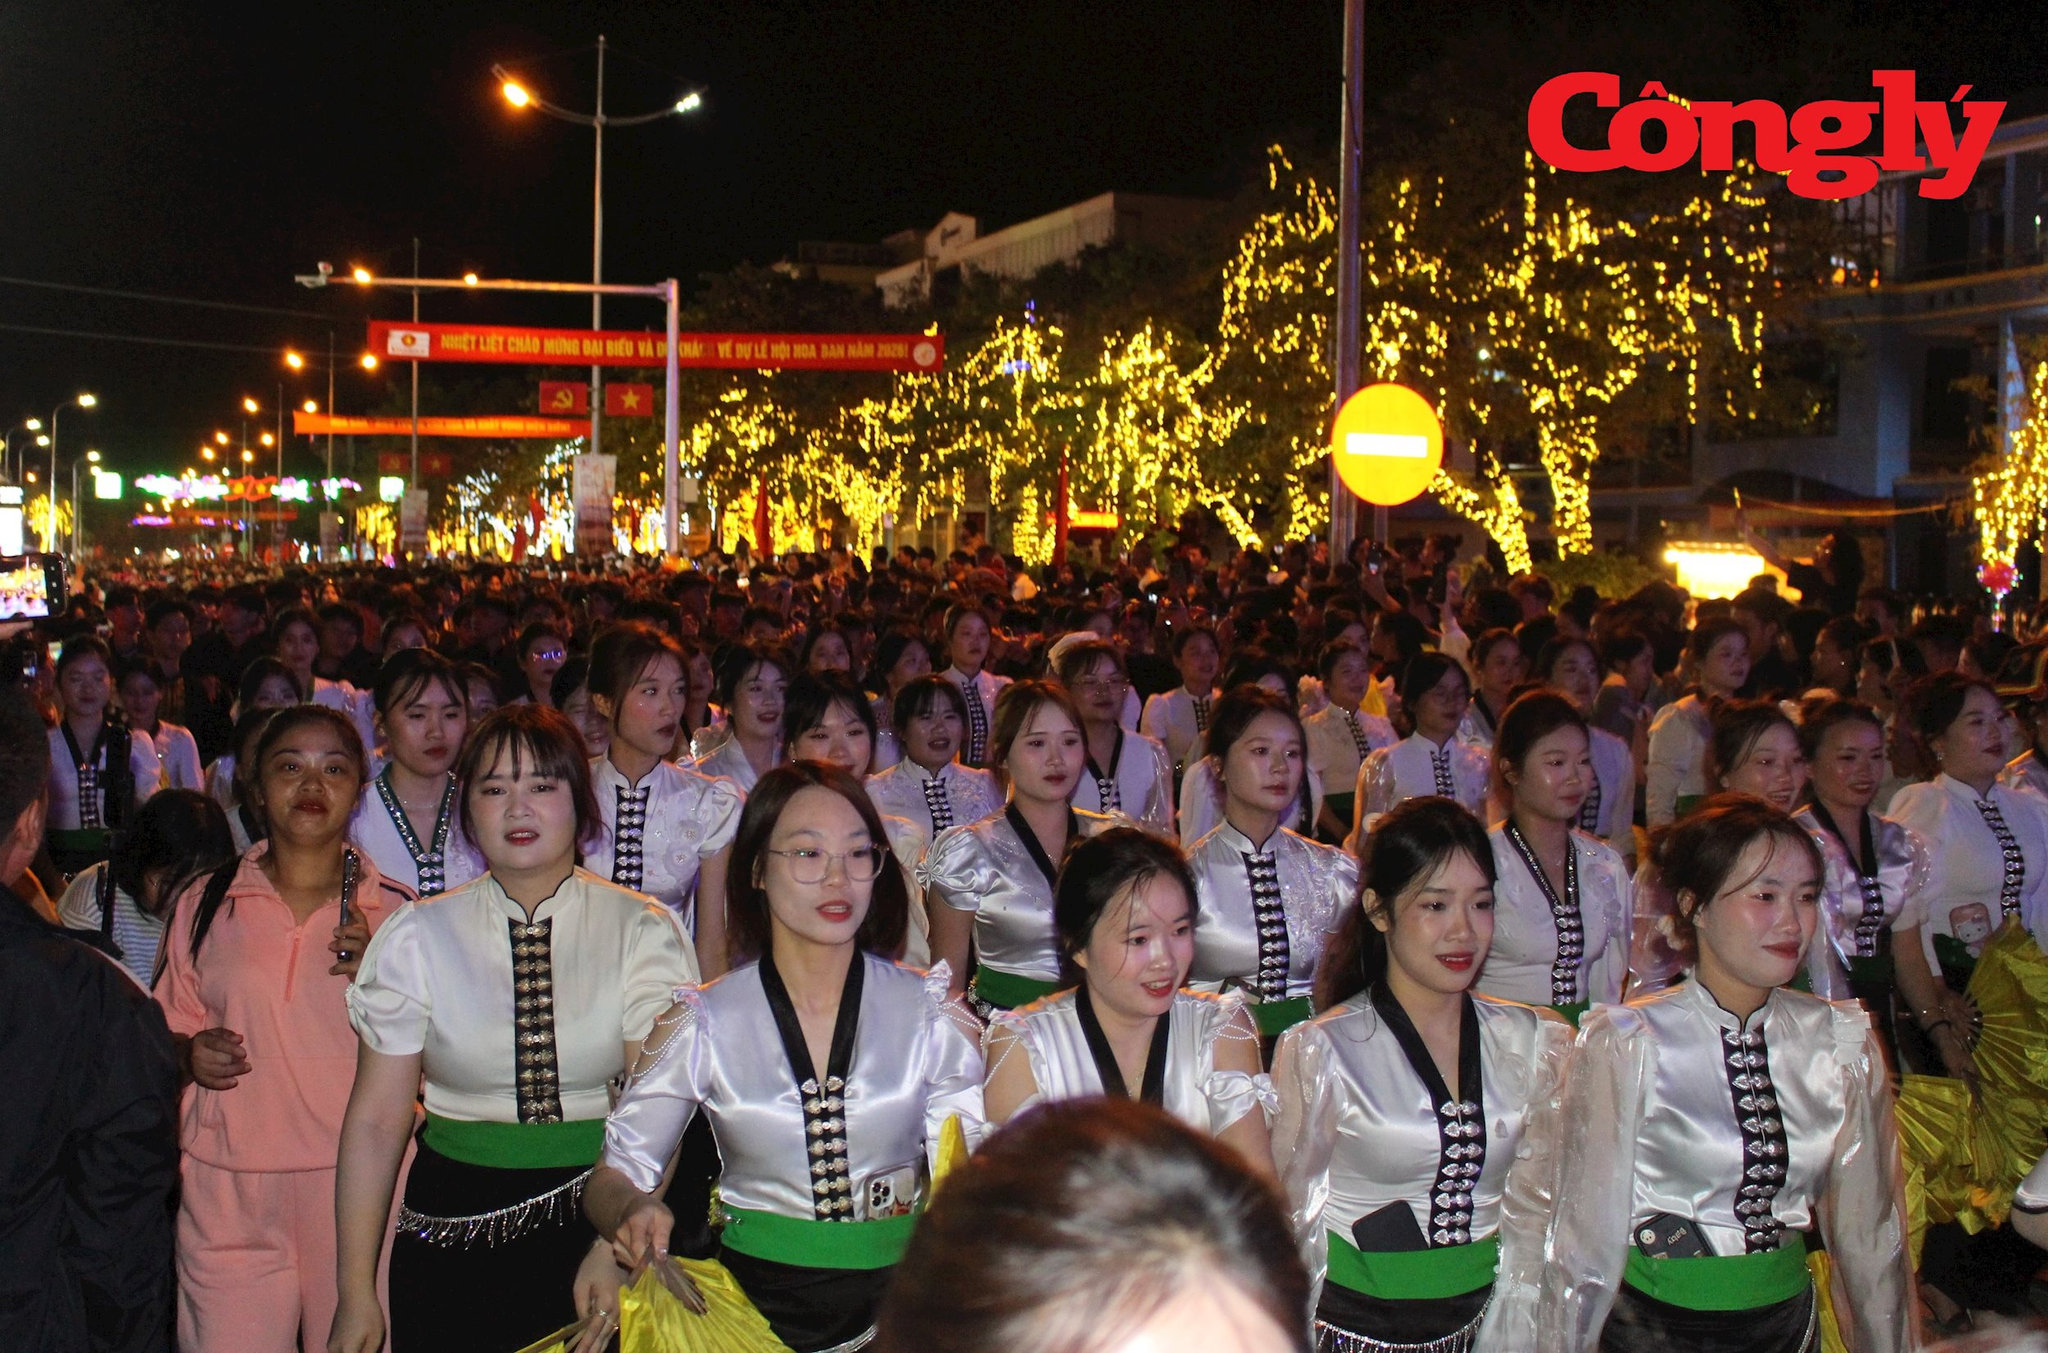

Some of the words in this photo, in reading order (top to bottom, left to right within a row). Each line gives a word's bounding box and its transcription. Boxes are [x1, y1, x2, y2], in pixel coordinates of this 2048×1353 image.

[441, 333, 476, 353] NHIỆT
[480, 333, 504, 354] LIỆT
[508, 335, 541, 354] CHÀO
[638, 338, 654, 358] VÀ
[794, 343, 817, 360] HOA
[822, 344, 845, 360] BAN
